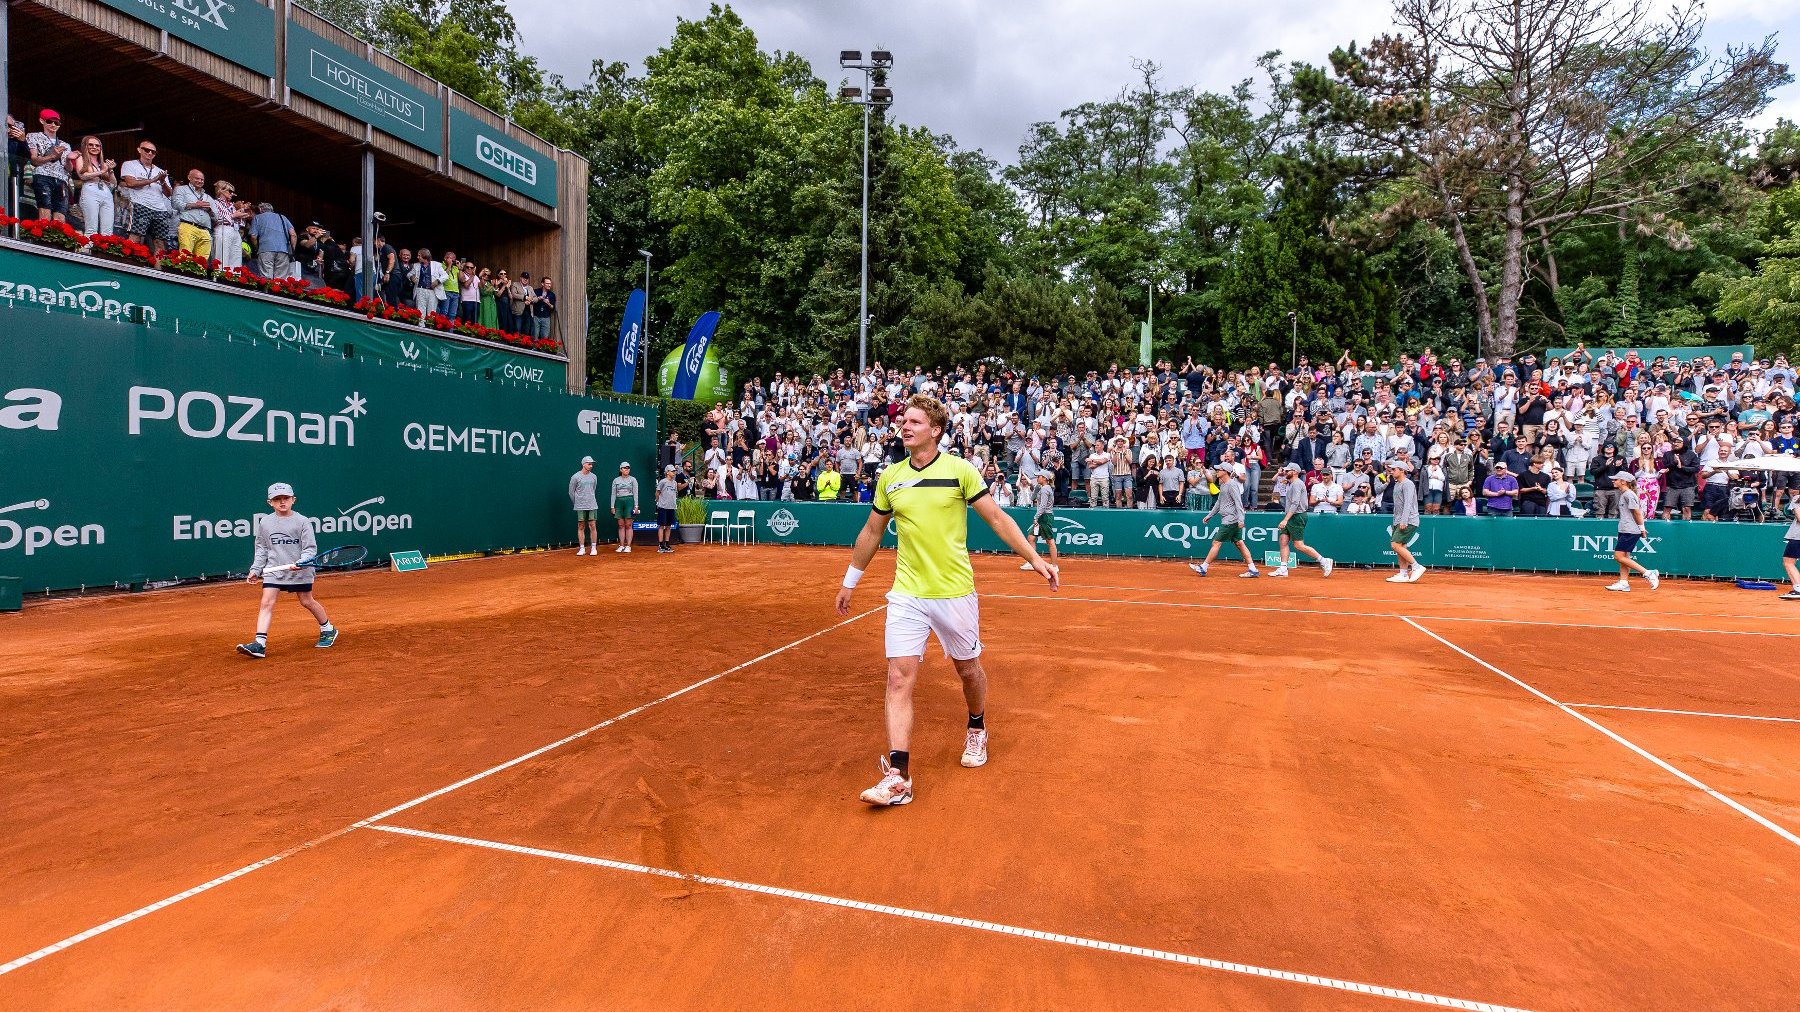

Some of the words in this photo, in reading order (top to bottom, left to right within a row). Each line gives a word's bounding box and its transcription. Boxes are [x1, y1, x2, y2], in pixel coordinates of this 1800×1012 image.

[169, 10, 177, 20] &
[181, 15, 201, 31] SPA
[327, 63, 372, 98] HOTEL
[374, 89, 413, 117] ALTUS
[480, 141, 533, 182] OSHEE
[263, 319, 336, 349] GOMEZ
[624, 322, 639, 365] Enea
[690, 335, 708, 375] Enea
[504, 363, 545, 383] GOMEZ
[601, 412, 645, 428] CHALLENGER
[601, 424, 620, 437] TOUR
[403, 422, 542, 456] QEMETICA
[271, 537, 300, 545] Enea
[1571, 535, 1657, 553] INTX
